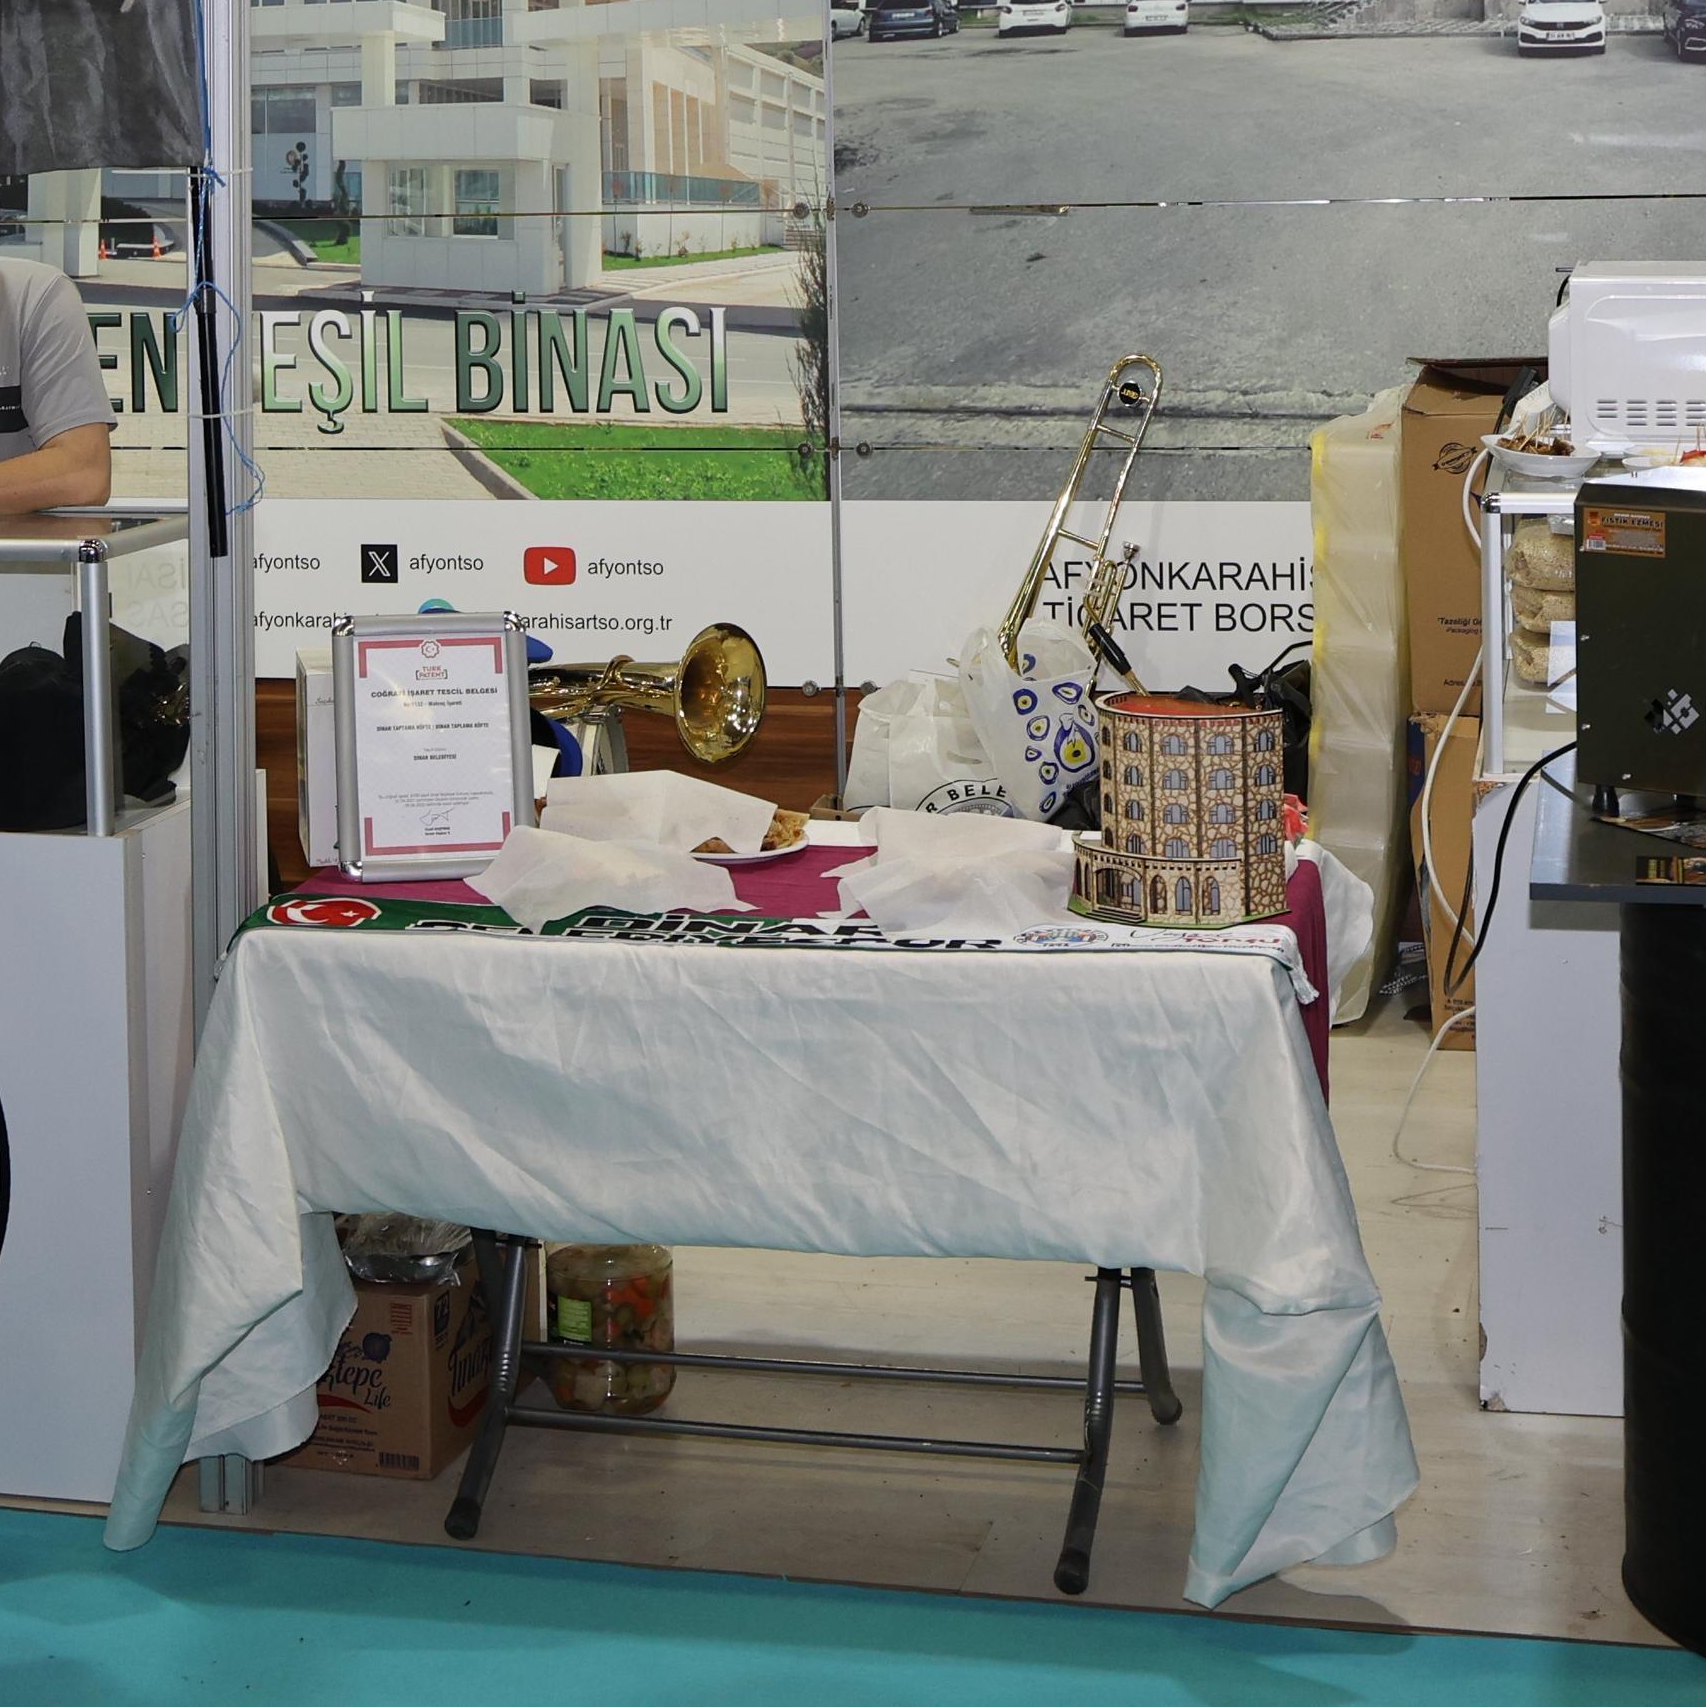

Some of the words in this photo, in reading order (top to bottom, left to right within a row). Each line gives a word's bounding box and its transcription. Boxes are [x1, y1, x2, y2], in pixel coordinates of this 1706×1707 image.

[259, 290, 429, 434] EŞİL
[455, 290, 729, 414] BİNASI
[409, 553, 484, 573] afyontso
[587, 558, 664, 578] afyontso
[364, 1386, 391, 1410] Life
